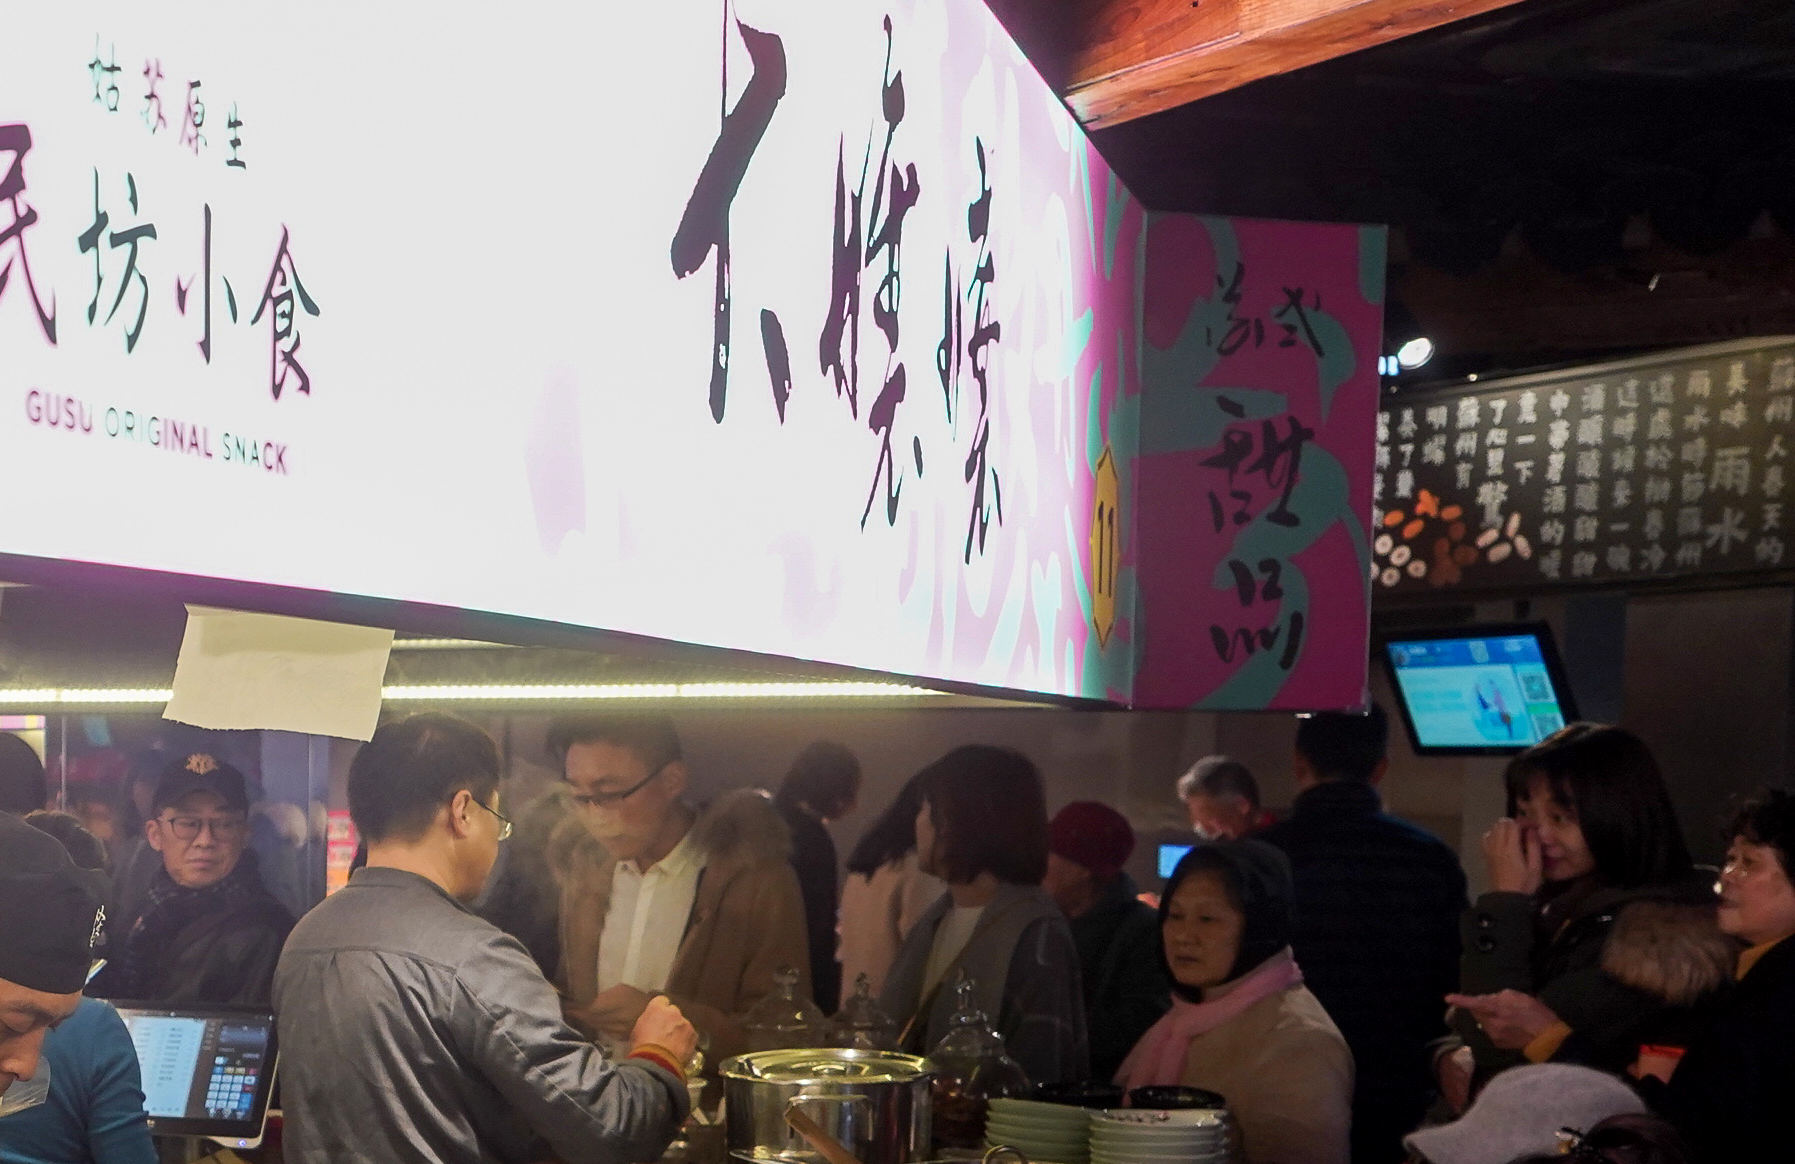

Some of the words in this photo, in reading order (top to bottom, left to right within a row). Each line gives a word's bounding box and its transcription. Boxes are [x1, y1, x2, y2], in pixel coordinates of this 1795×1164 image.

[26, 389, 93, 433] GUSU
[105, 406, 213, 459] ORIGINAL
[222, 432, 288, 475] SNACK
